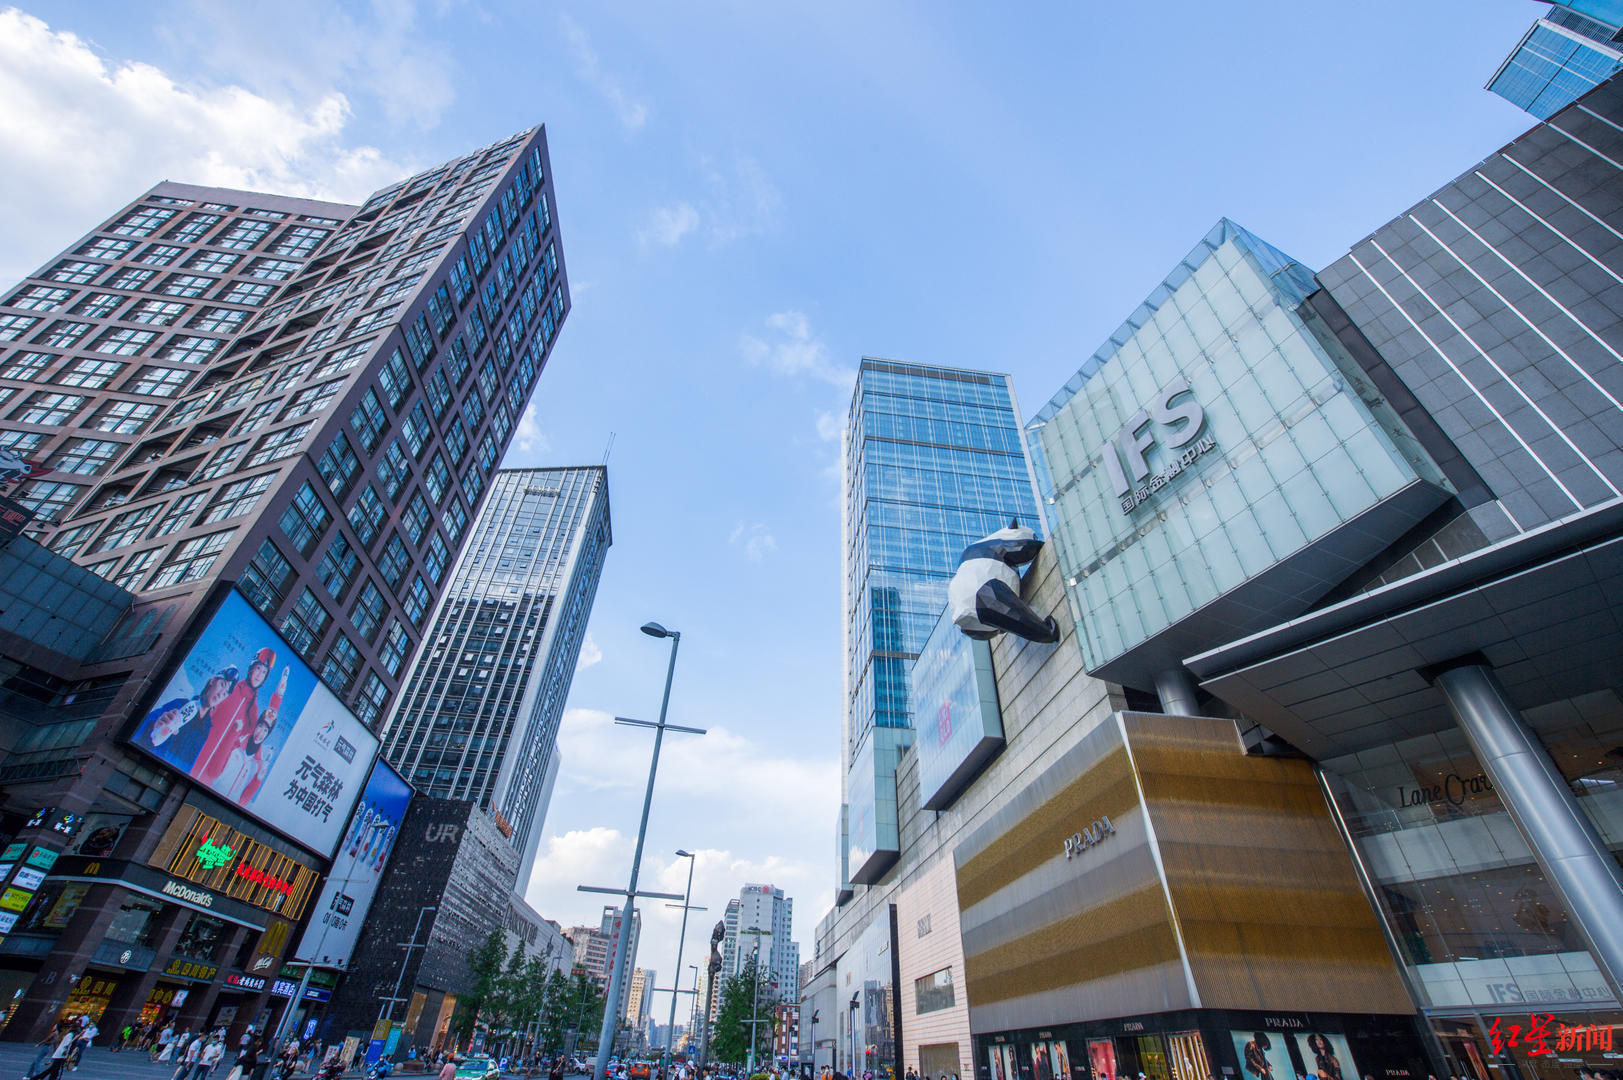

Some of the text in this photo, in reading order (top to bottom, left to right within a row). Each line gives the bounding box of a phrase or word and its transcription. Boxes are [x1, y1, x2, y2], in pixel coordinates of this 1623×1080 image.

[1101, 380, 1208, 498] IFS
[1121, 434, 1217, 516] 国际金融中心
[295, 754, 343, 802] 元气森林
[283, 779, 333, 823] 为中国打气
[1398, 784, 1441, 808] Lane
[425, 822, 459, 844] UR
[1064, 815, 1116, 859] PRADA
[162, 880, 213, 907] McDonald's
[1487, 983, 1522, 1004] IFS
[1525, 985, 1613, 1002] 国际金融中心
[1265, 1017, 1304, 1028] PRADA
[1385, 1068, 1411, 1076] PRADA
